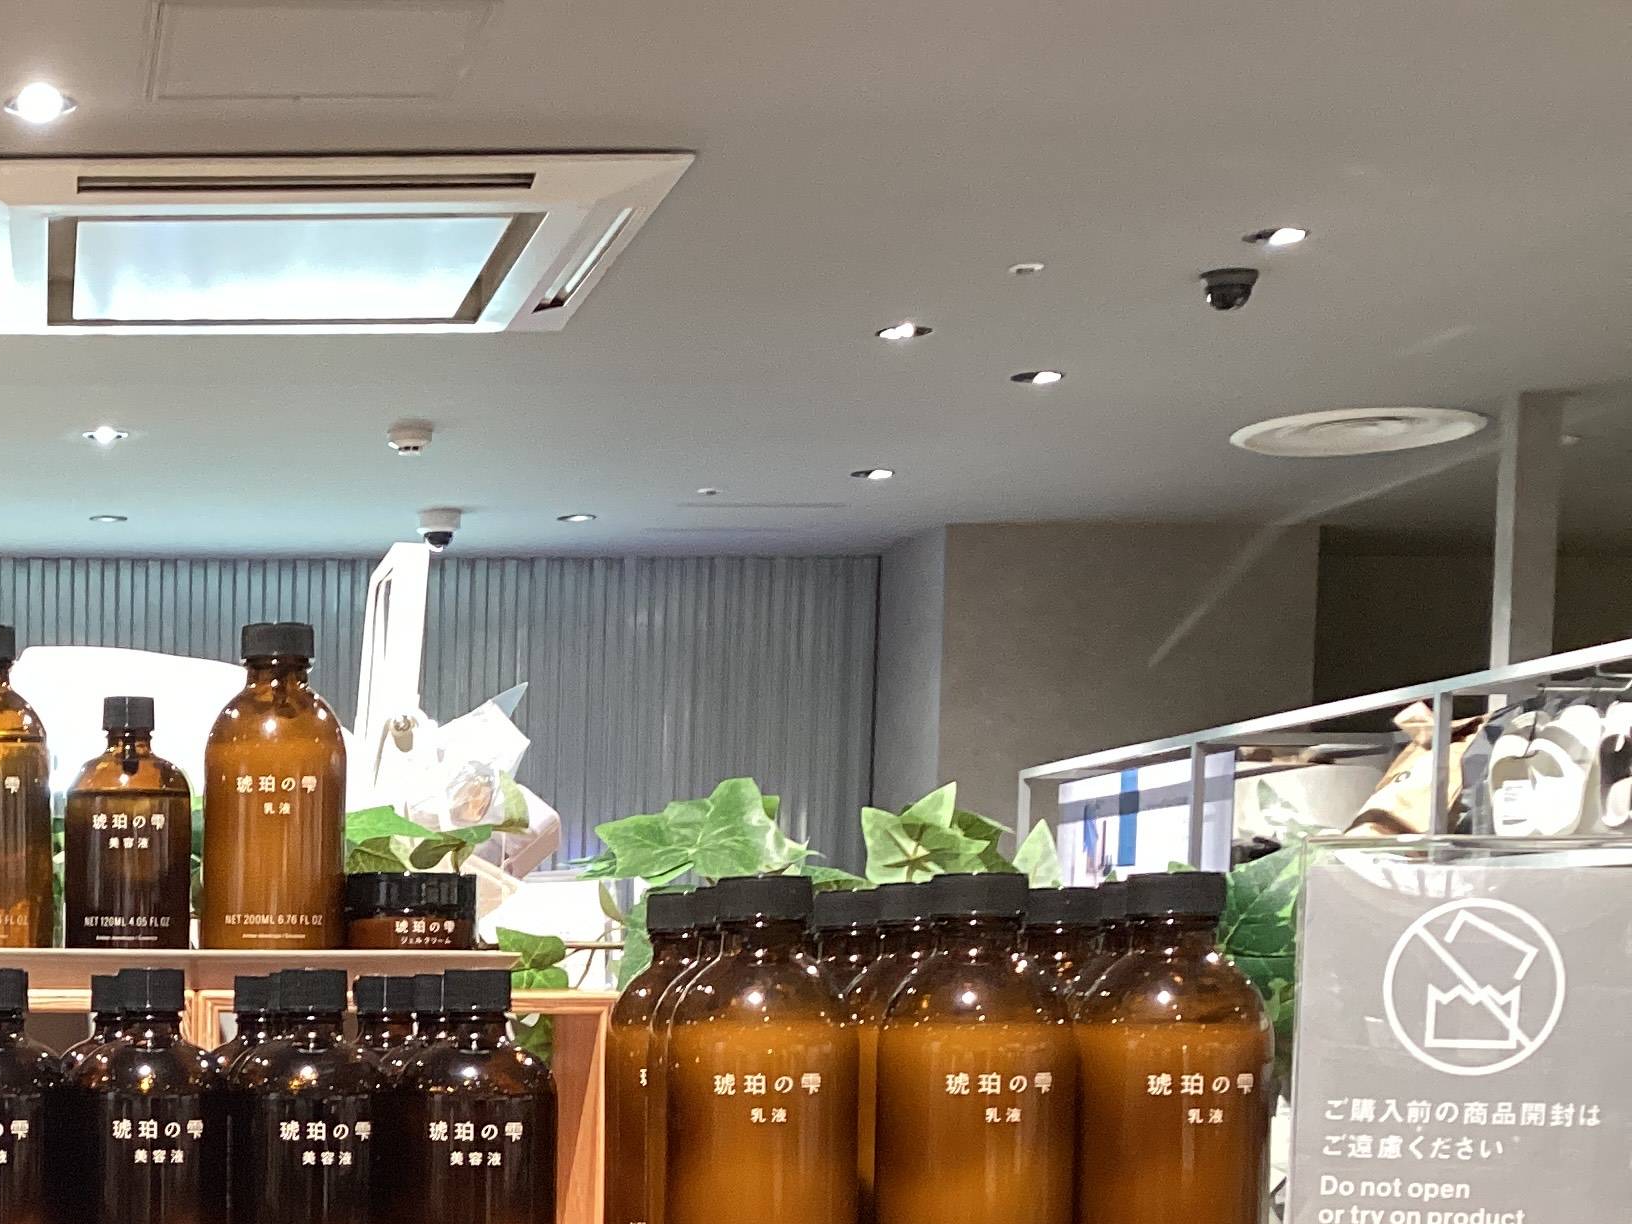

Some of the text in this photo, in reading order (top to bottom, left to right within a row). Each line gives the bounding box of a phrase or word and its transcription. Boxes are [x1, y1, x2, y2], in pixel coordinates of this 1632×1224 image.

[236, 774, 317, 795] 琥珀の雫
[264, 802, 290, 814] 乳液
[93, 813, 165, 830] 琥珀の雫
[109, 837, 148, 848] 美容液
[395, 917, 455, 933] 琥珀の雫
[714, 1073, 821, 1095] 琥珀の雫
[946, 1072, 1052, 1095] 琥珀の雫
[1147, 1073, 1253, 1095] 琥珀の雫
[751, 1108, 786, 1123] 乳液
[986, 1108, 1021, 1122] 乳液
[1188, 1109, 1223, 1124] 乳液
[1325, 1097, 1600, 1128] ご購入前の商品開封は
[113, 1119, 203, 1139] 琥珀の雫
[280, 1120, 370, 1141] 琥珀の雫
[429, 1121, 523, 1142] 琥珀の雫
[1323, 1134, 1503, 1160] ご遠慮ください
[135, 1149, 183, 1163] 美容液
[303, 1151, 351, 1165] 美容液
[450, 1151, 501, 1166] 美容液
[1320, 1175, 1470, 1202] Do not open
[1318, 1209, 1345, 1224] or
